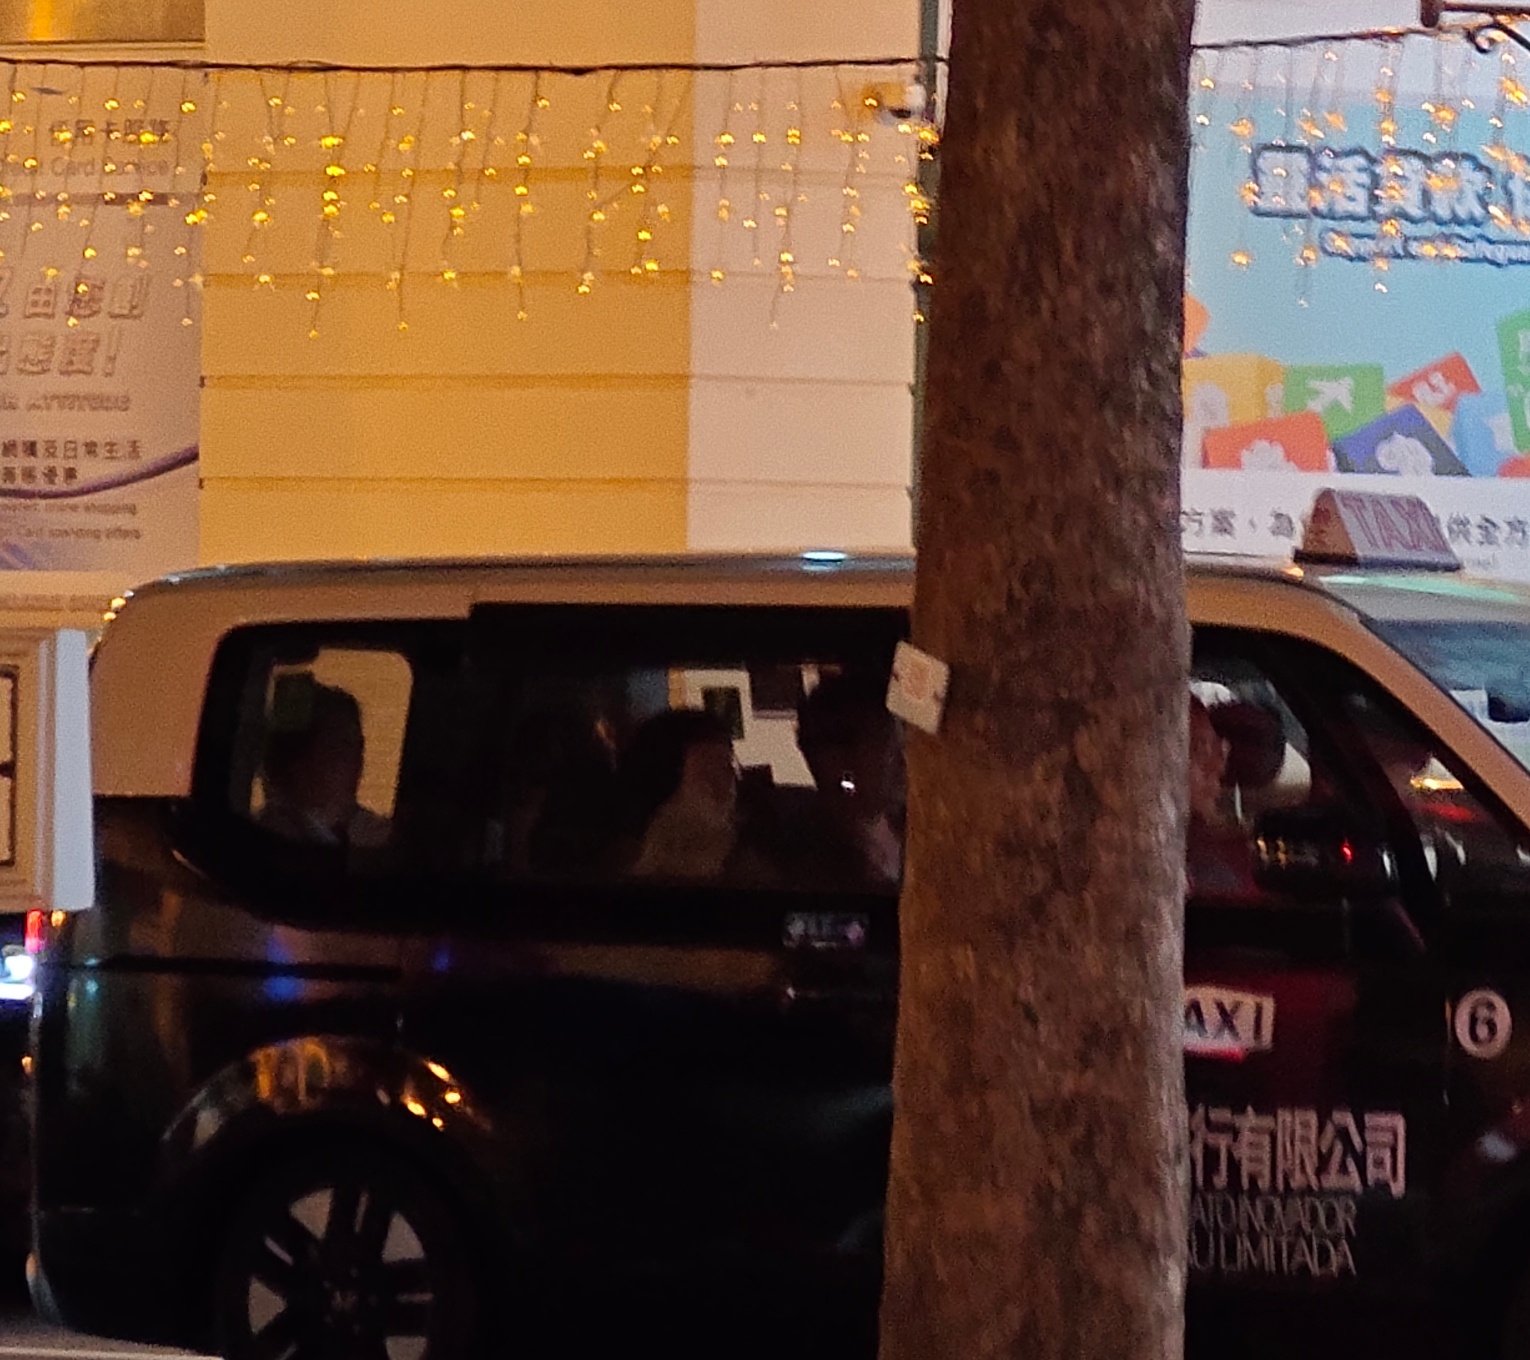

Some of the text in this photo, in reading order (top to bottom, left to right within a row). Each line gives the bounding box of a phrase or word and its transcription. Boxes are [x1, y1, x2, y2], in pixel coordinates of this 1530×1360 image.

[1340, 492, 1449, 555] TAXI
[1188, 1102, 1407, 1199] 行有限公司
